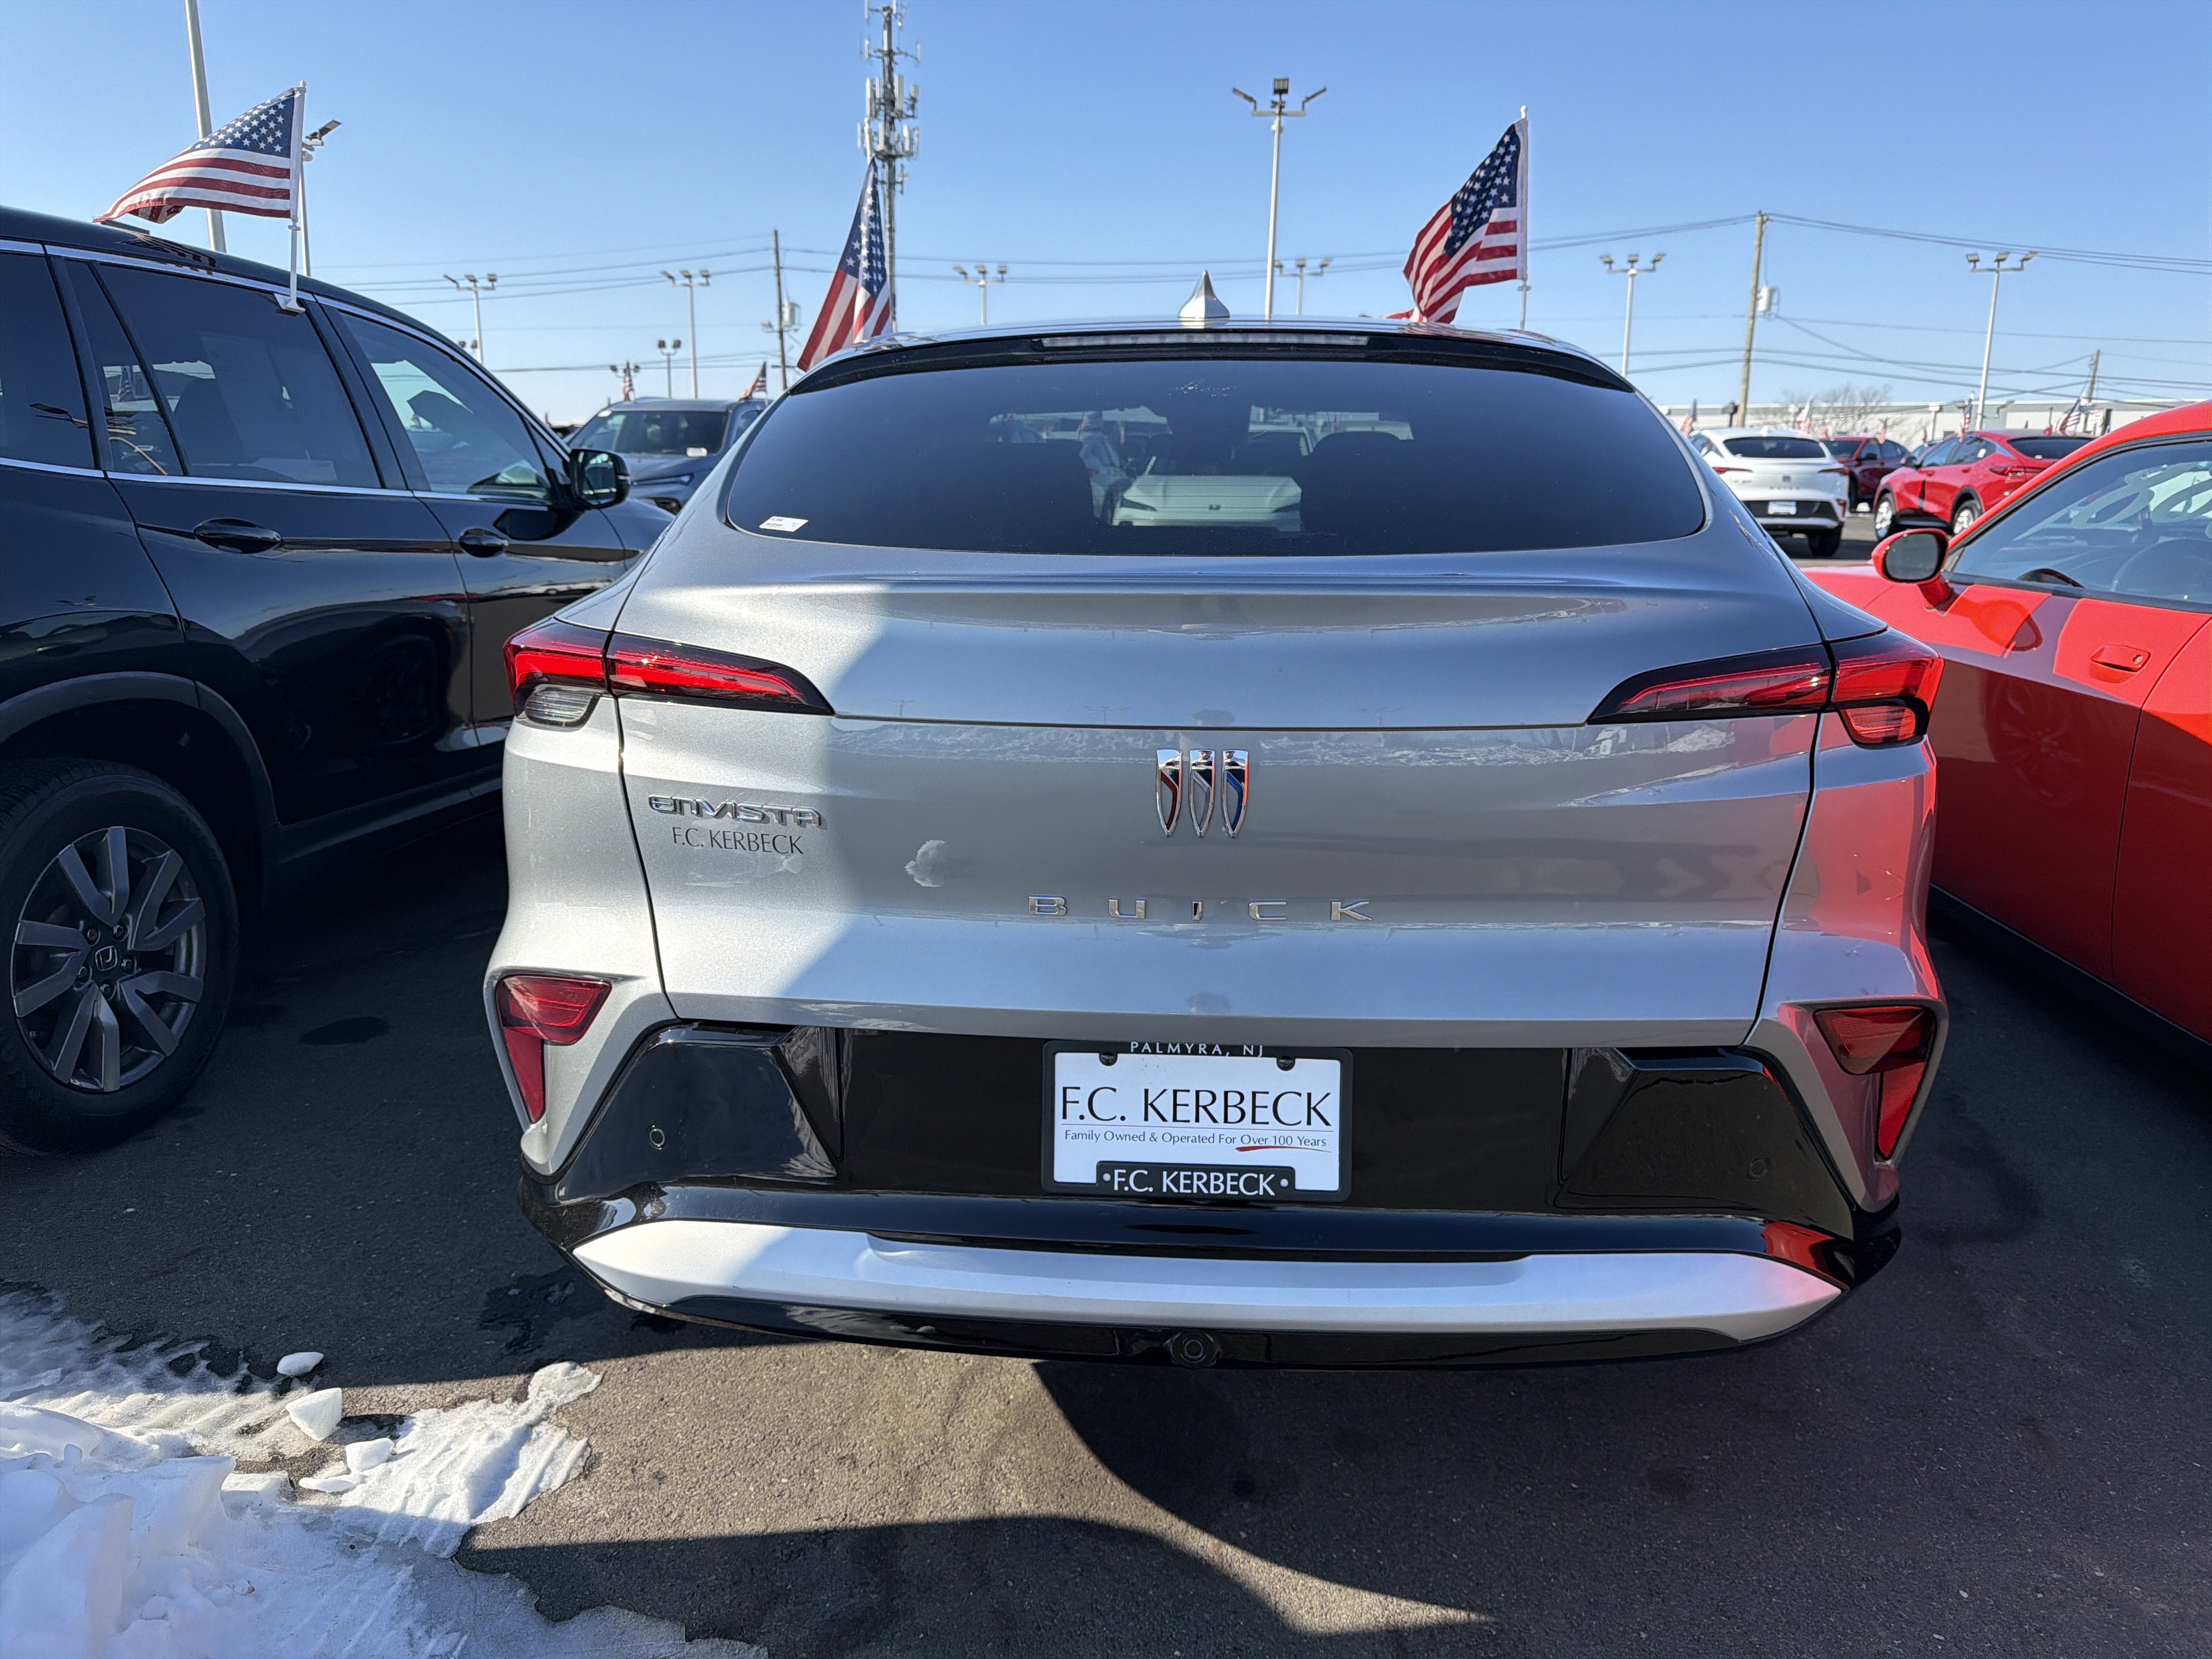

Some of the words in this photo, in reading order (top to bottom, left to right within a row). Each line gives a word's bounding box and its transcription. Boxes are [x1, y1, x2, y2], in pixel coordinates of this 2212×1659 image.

[673, 827, 704, 848] F.C.
[709, 830, 804, 855] KERBECK
[1028, 894, 1372, 922] BUICK
[1130, 1041, 1230, 1057] PALMYRA,
[1243, 1045, 1262, 1057] NJ
[1062, 1086, 1126, 1122] F.C.
[1143, 1087, 1332, 1127] KERBECK
[1065, 1130, 1101, 1143] Family
[1104, 1130, 1146, 1142] Owned
[1149, 1132, 1158, 1142] &
[1161, 1131, 1215, 1145] Operated
[1219, 1134, 1237, 1144] For
[1241, 1135, 1268, 1145] Over
[1273, 1136, 1293, 1146] 100
[1297, 1136, 1327, 1147] Years
[1113, 1169, 1153, 1192] F.C.
[1162, 1171, 1276, 1197] KERBECK
